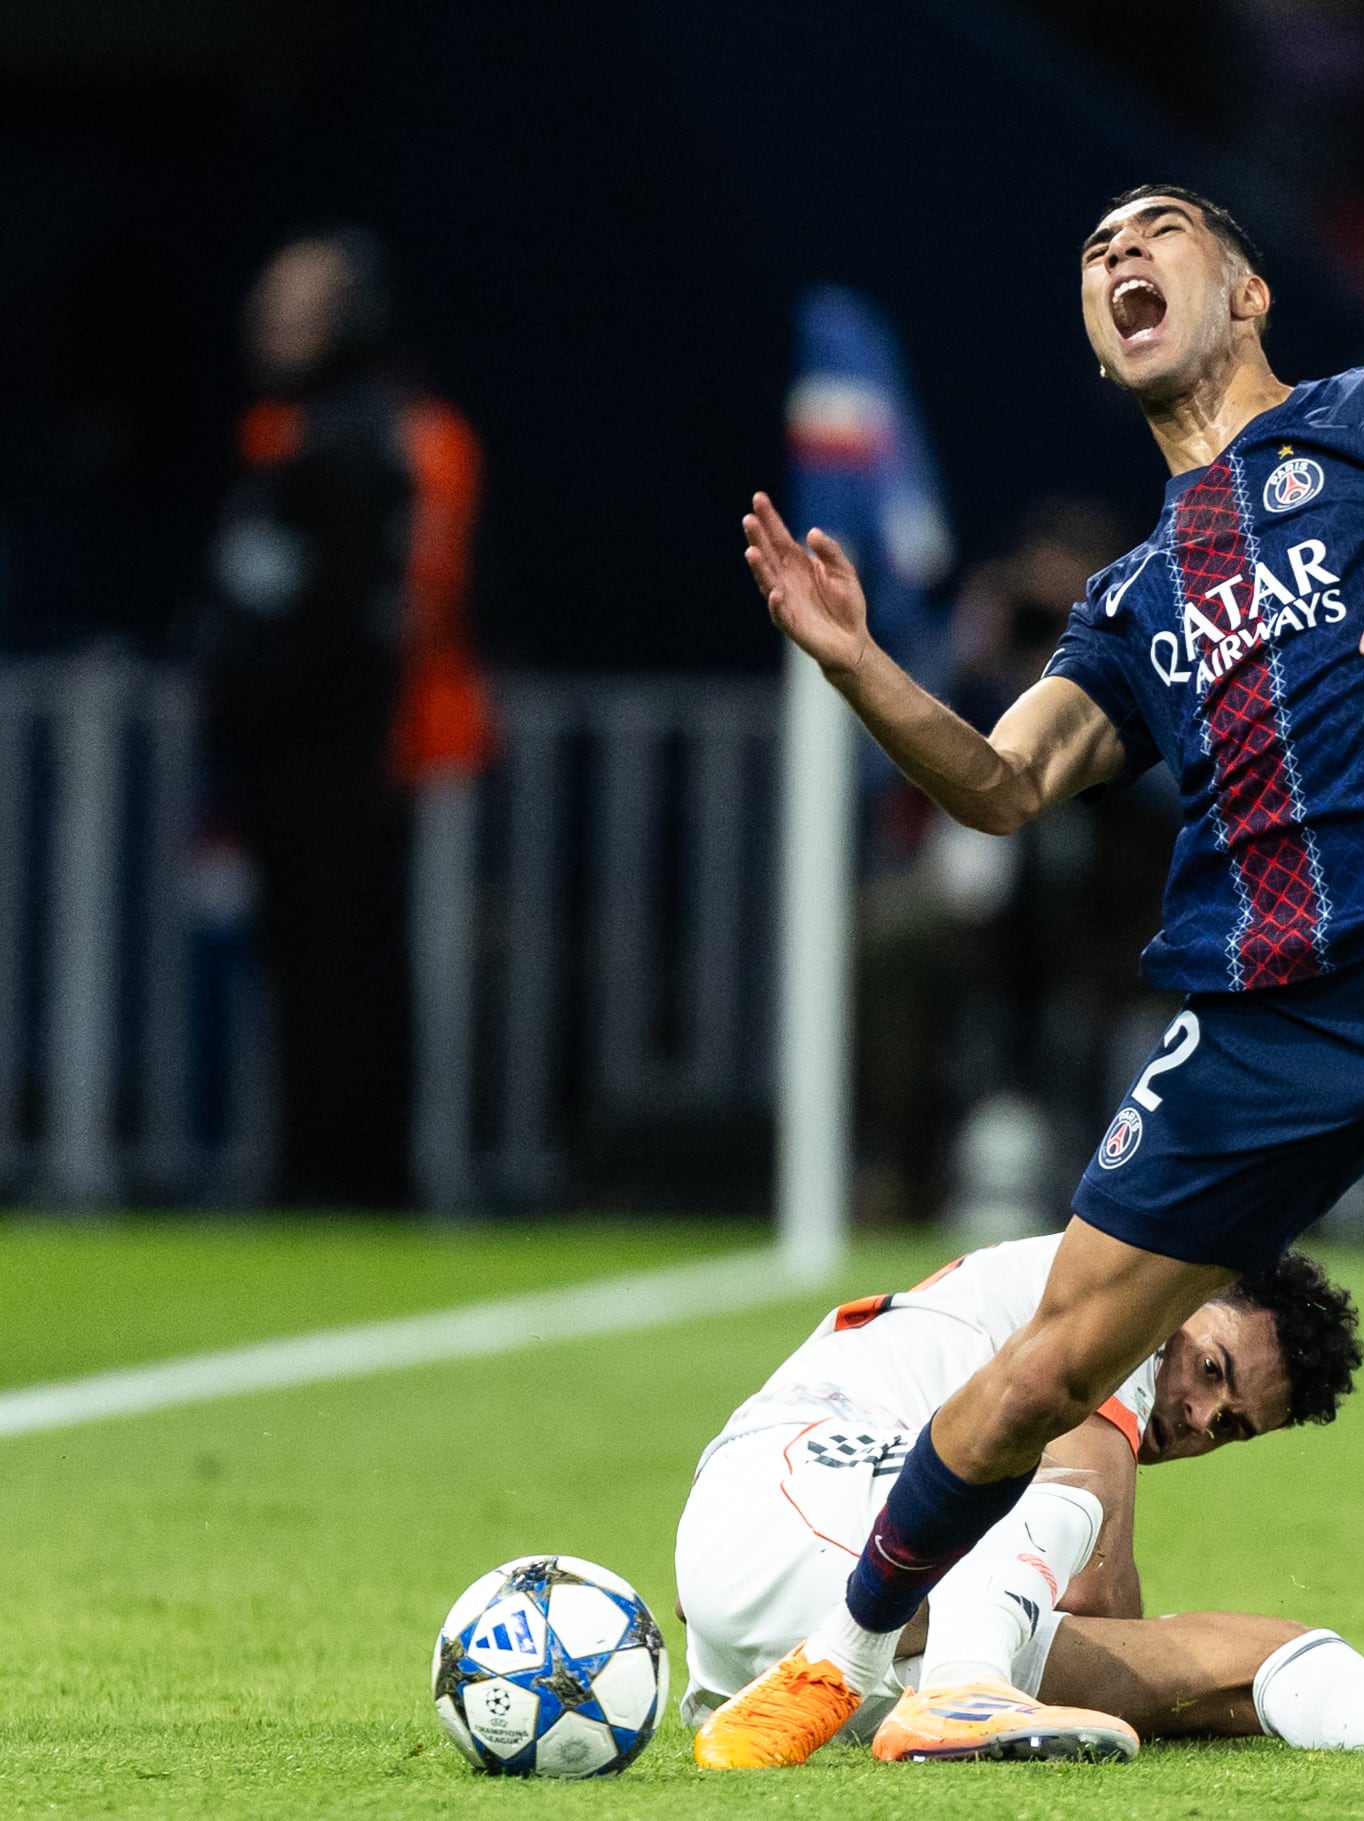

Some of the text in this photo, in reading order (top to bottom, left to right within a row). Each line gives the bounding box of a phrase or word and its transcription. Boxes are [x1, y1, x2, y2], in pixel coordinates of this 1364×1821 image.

[1269, 461, 1309, 485] PARIS
[1150, 539, 1340, 687] QATAR
[1195, 588, 1347, 693] AIRWAYS
[1131, 1009, 1200, 1112] 2
